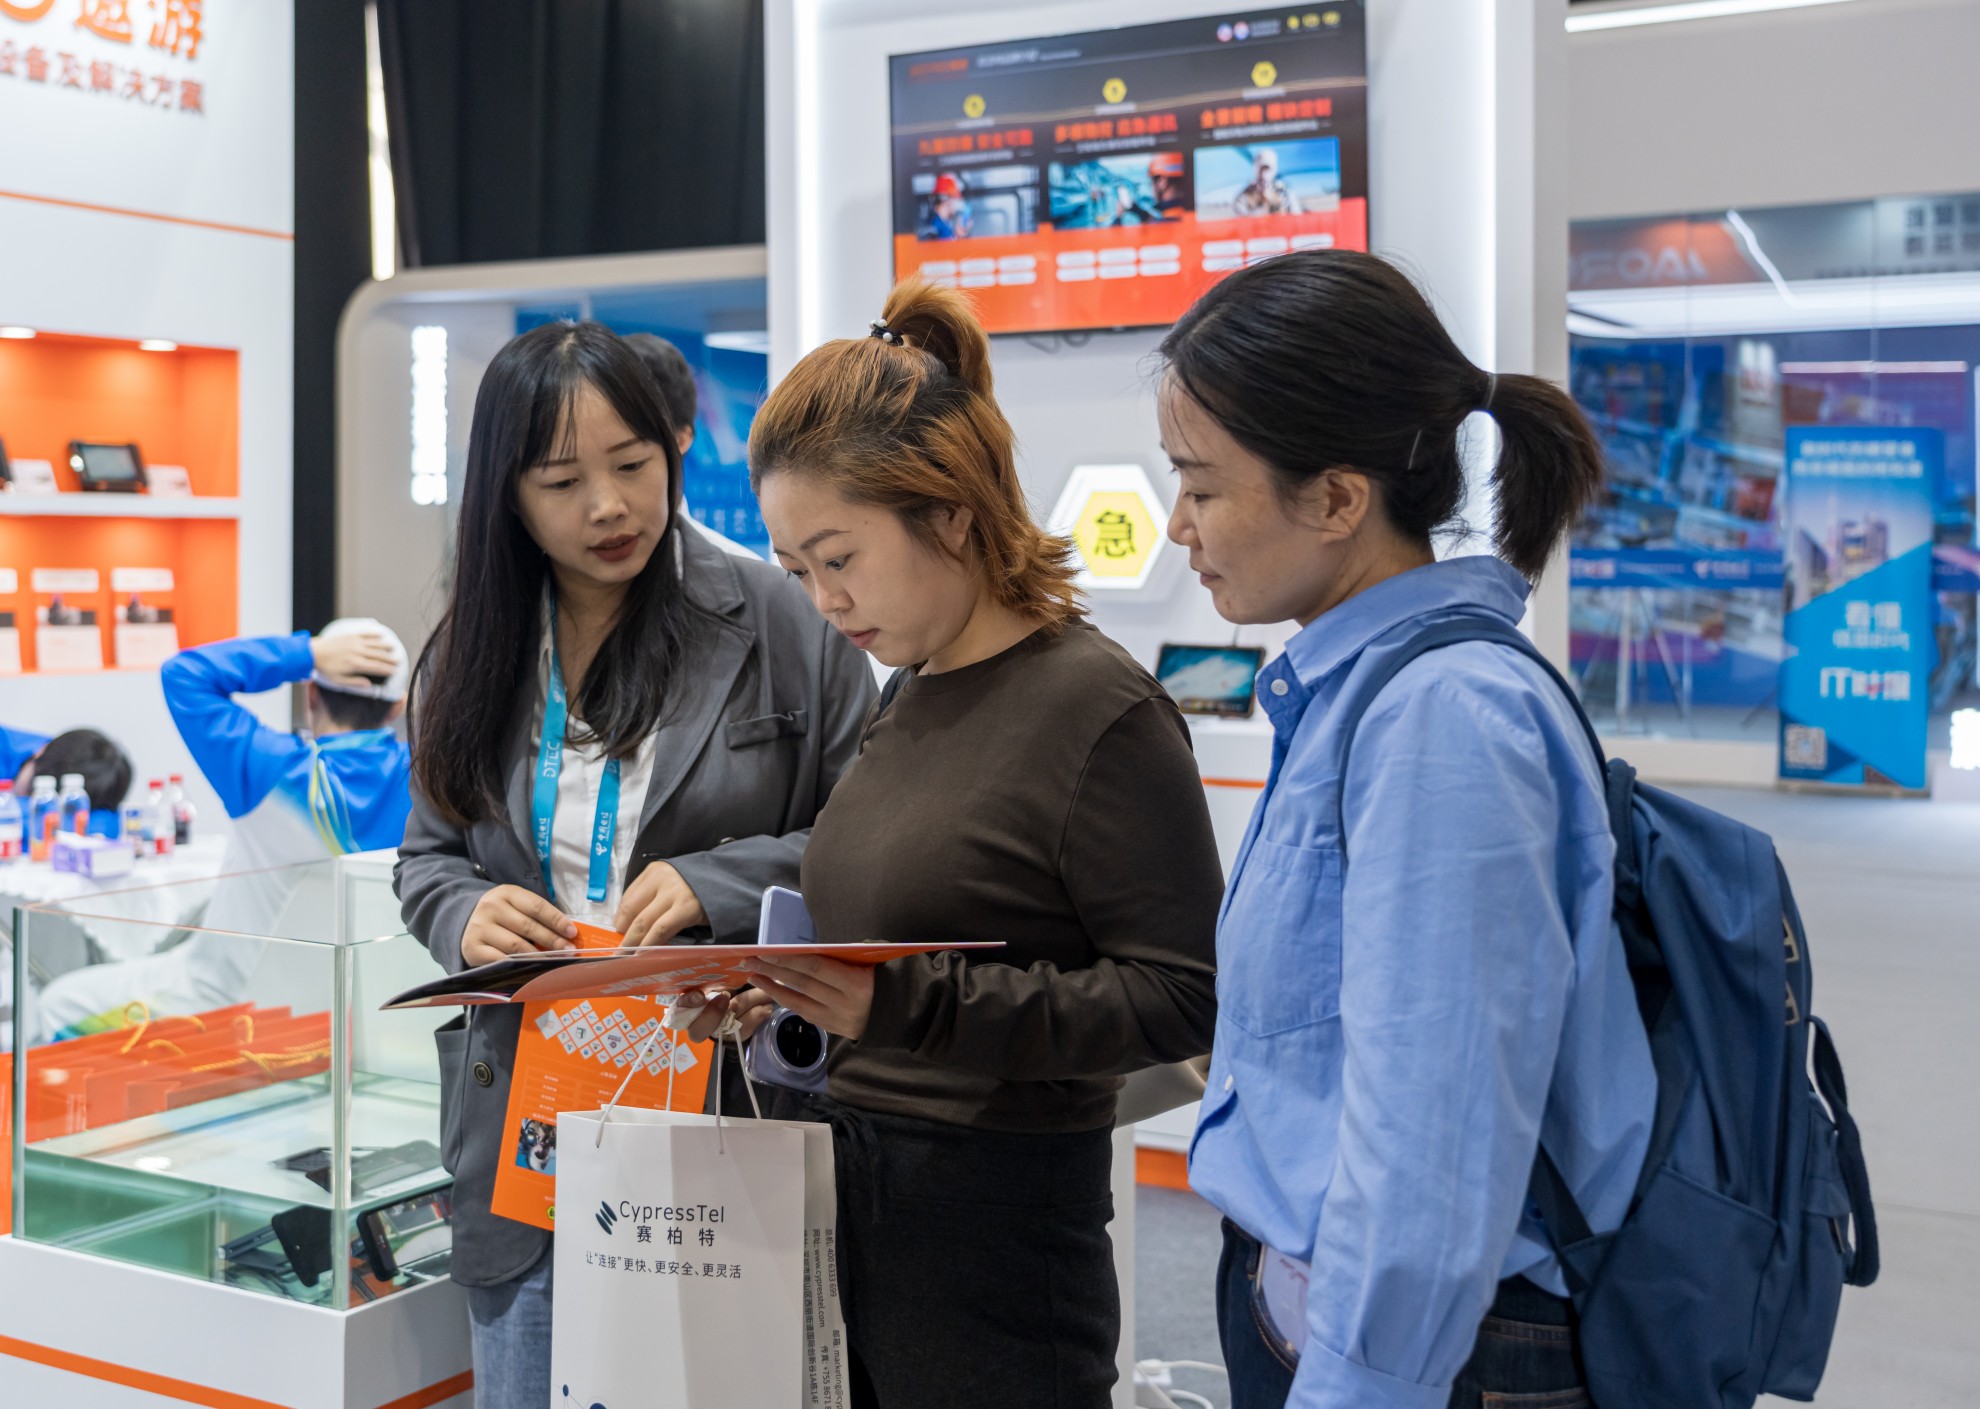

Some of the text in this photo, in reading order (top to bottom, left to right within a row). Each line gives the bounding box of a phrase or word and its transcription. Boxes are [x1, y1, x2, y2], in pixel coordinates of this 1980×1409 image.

[1093, 510, 1136, 558] 急
[619, 1200, 725, 1223] CypressTel
[637, 1225, 715, 1247] 赛柏特
[827, 1248, 835, 1262] 400
[828, 1263, 837, 1282] 6333
[814, 1249, 826, 1328] www.cypresstel.com
[829, 1283, 838, 1297] 699
[822, 1366, 830, 1384] +755
[823, 1386, 832, 1404] 8671
